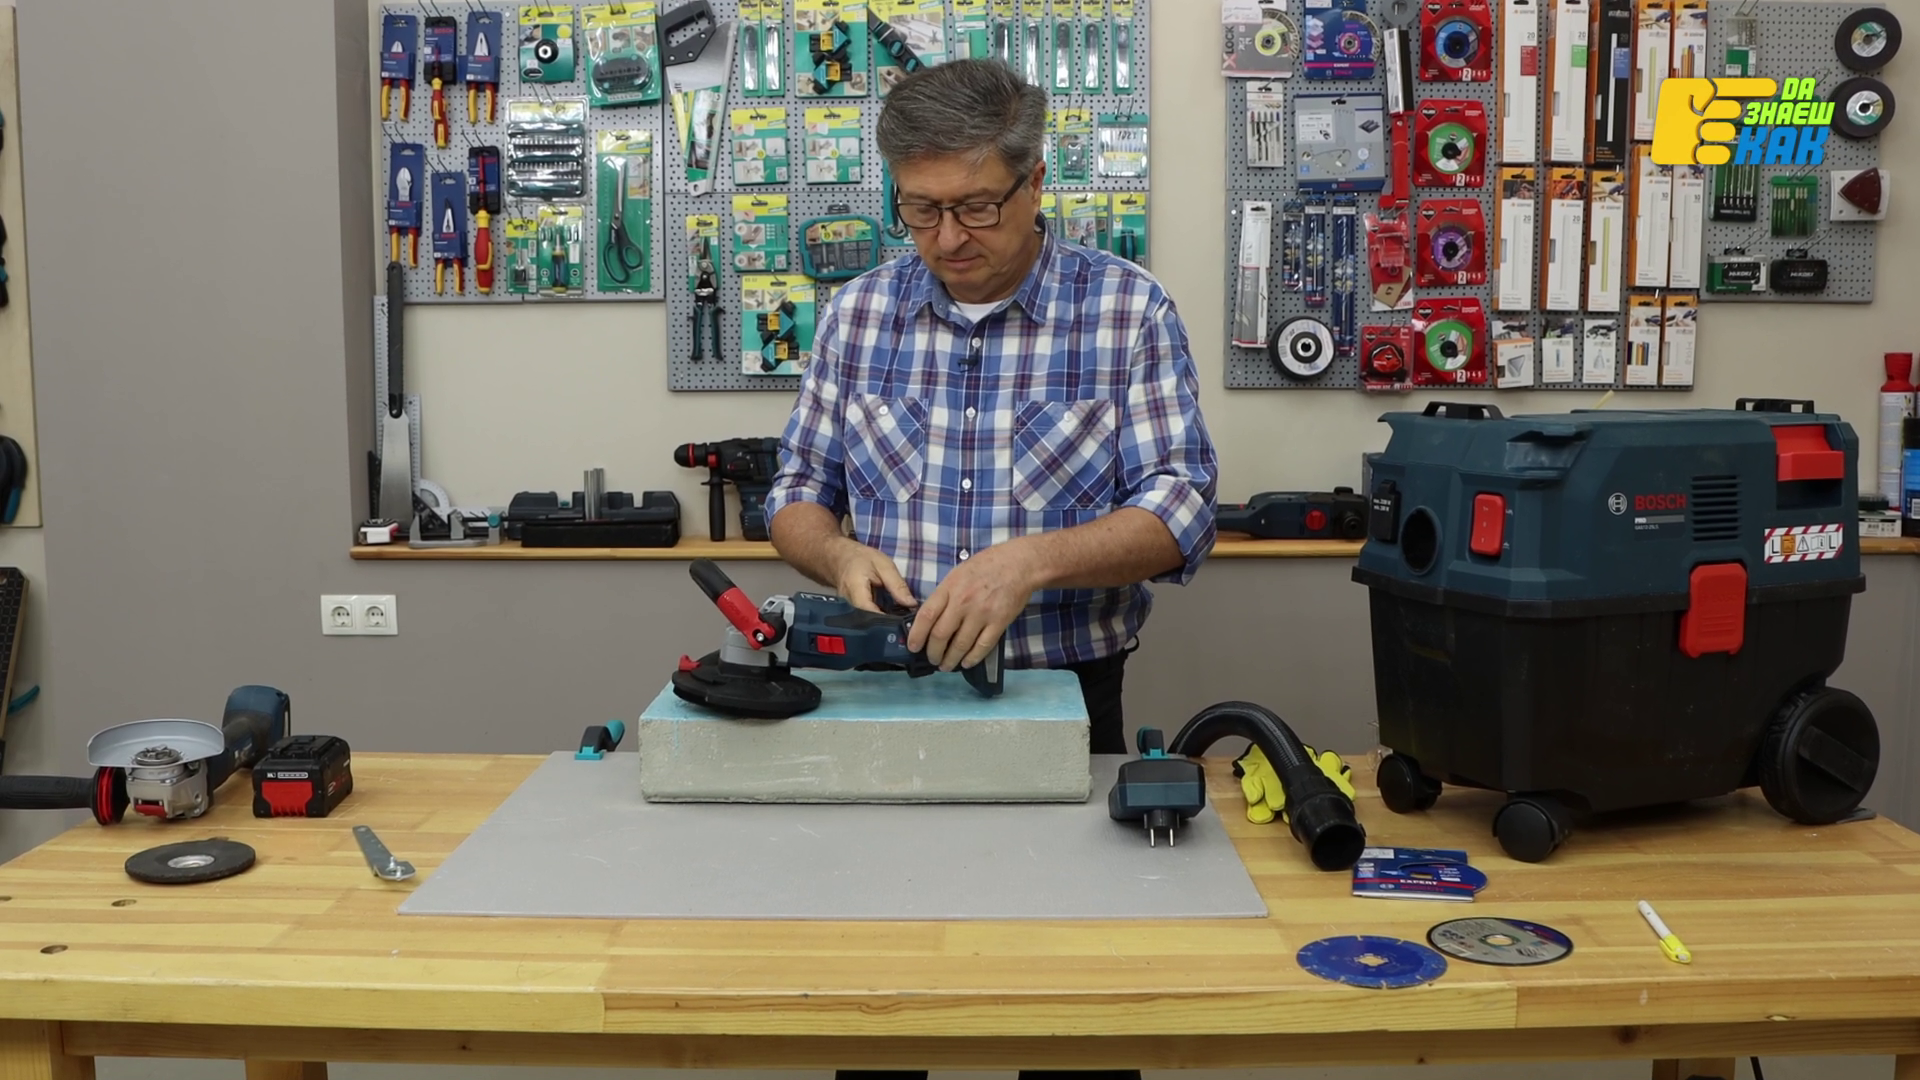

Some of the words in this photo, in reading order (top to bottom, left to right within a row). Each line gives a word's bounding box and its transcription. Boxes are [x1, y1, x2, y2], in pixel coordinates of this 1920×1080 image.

[1578, 31, 1587, 39] 20
[1635, 494, 1687, 511] BOSCH
[1771, 539, 1780, 554] L
[1828, 534, 1837, 549] L
